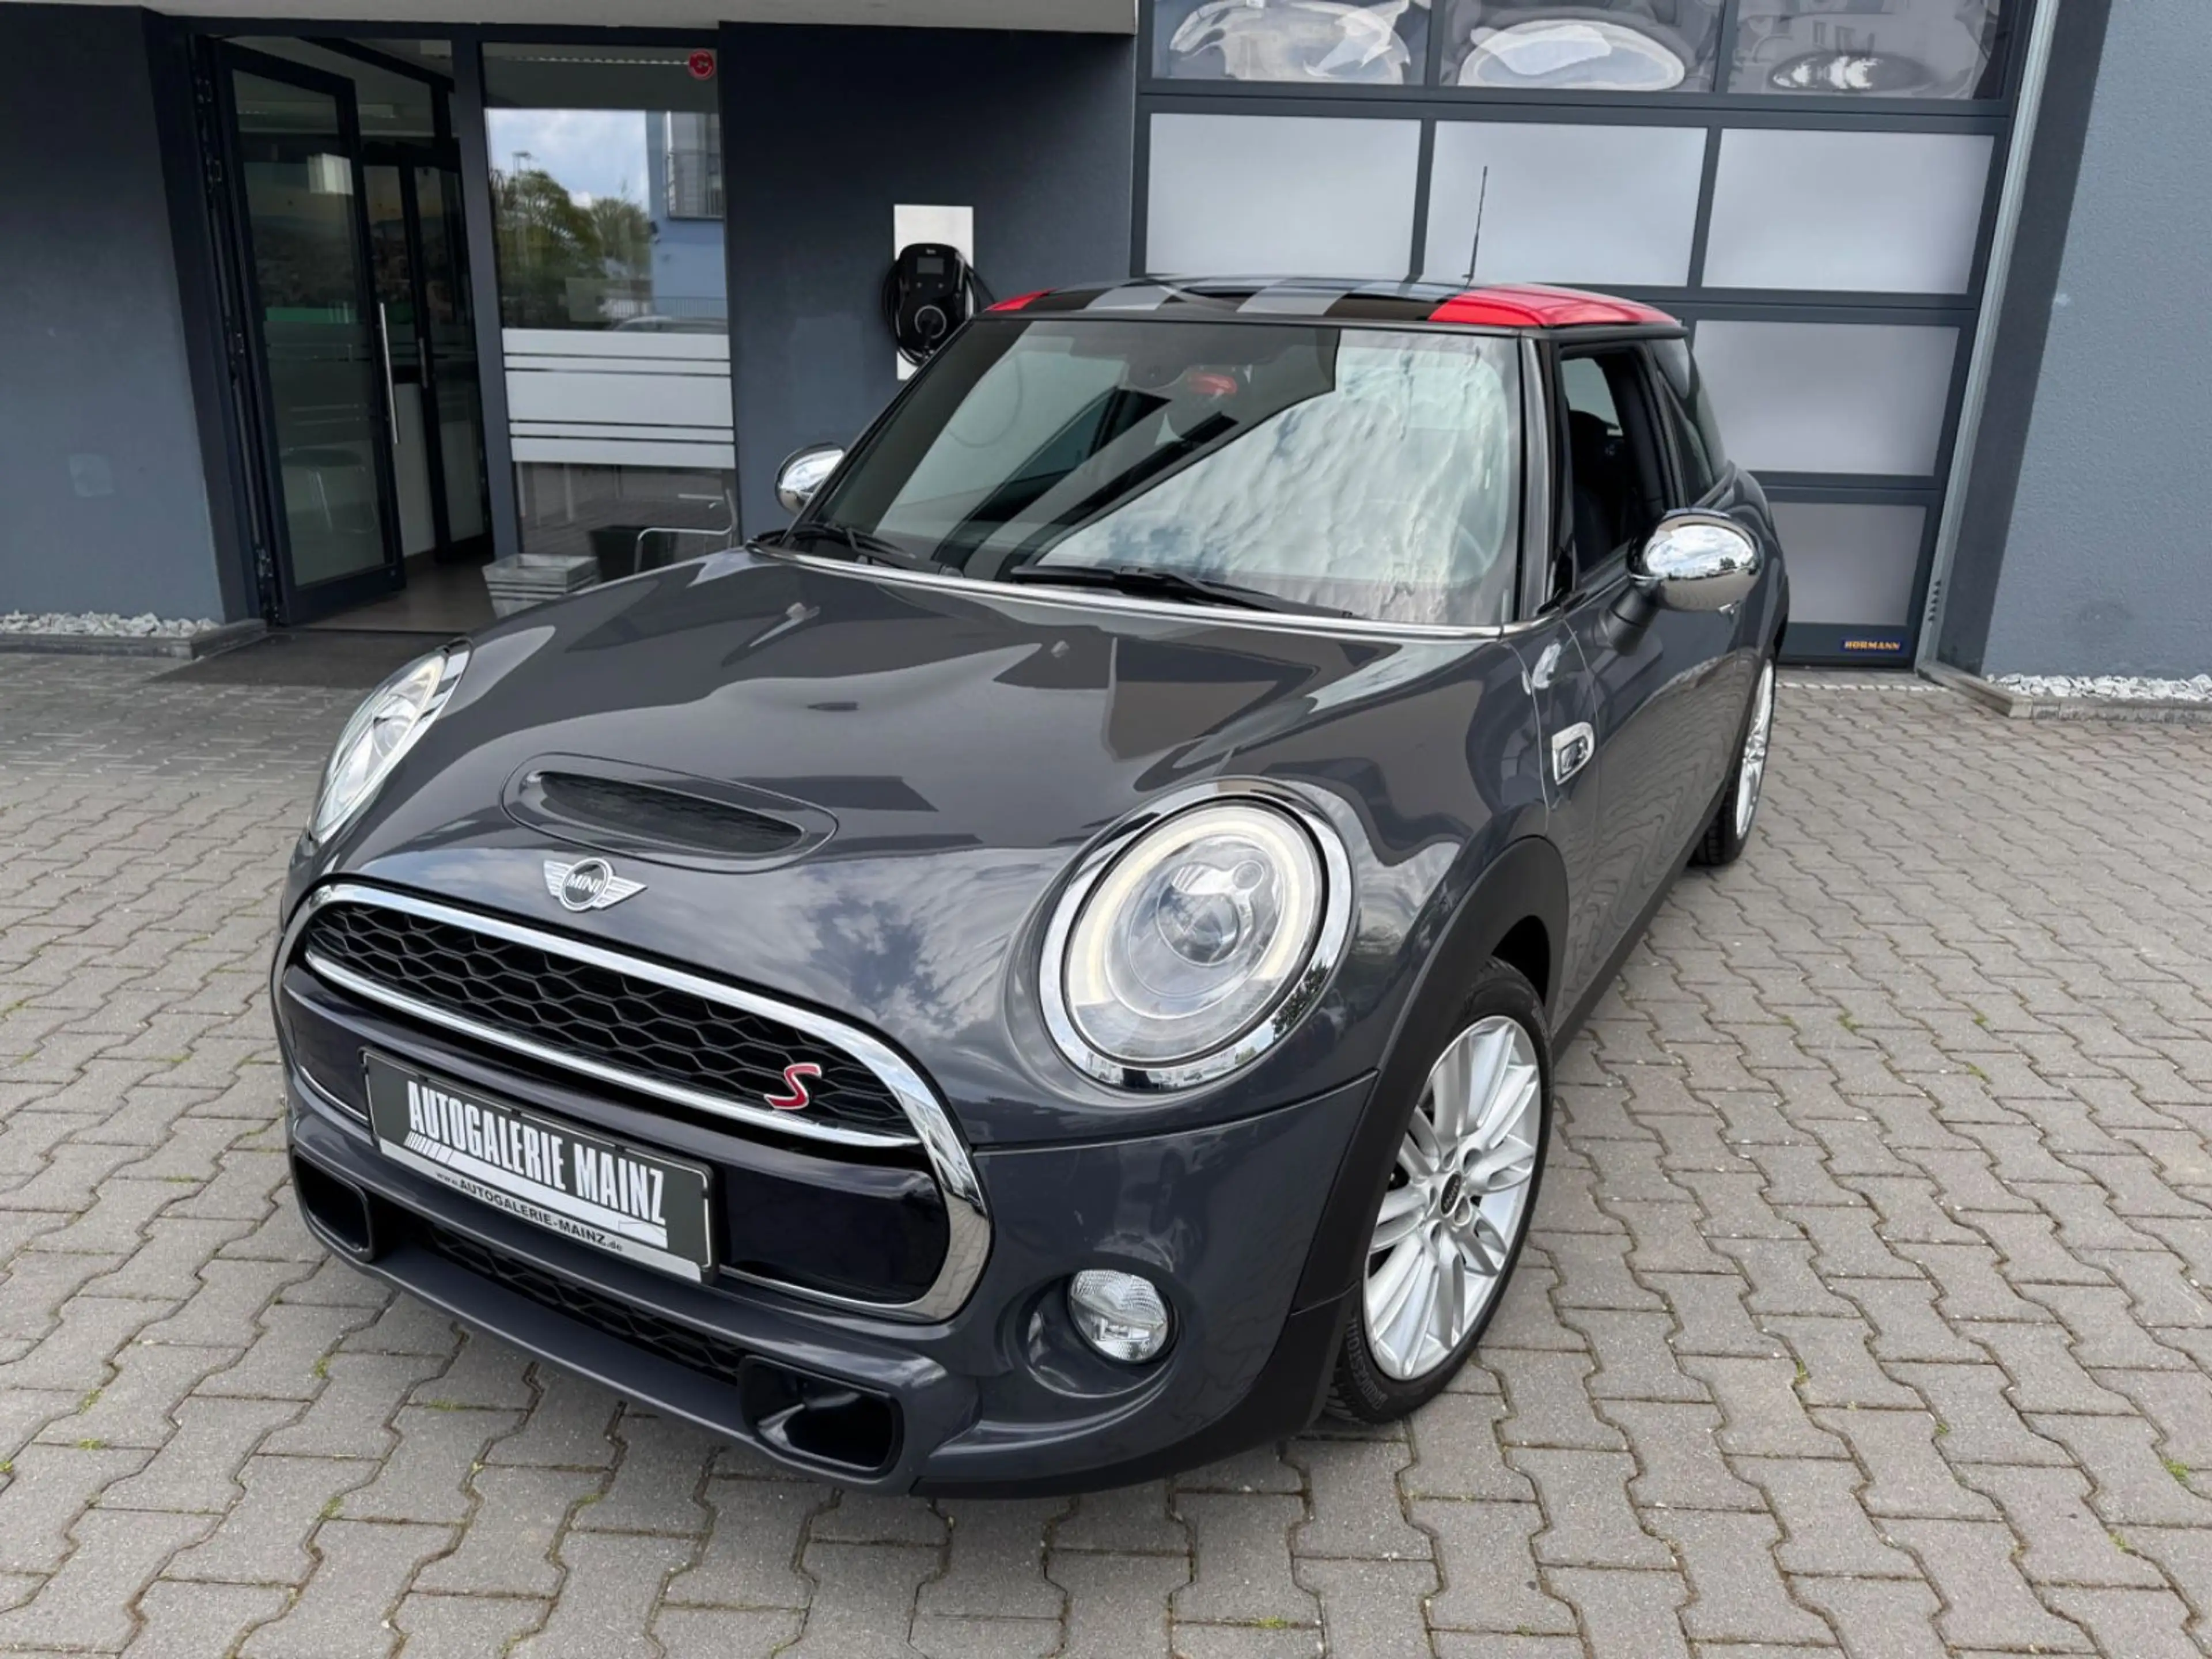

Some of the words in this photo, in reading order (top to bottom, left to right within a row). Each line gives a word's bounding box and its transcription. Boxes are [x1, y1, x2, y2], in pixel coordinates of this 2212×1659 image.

[567, 873, 604, 892] MINI
[763, 1062, 822, 1109] S
[407, 1080, 566, 1191] AUTOGALERIE
[573, 1143, 666, 1224] MAINZ
